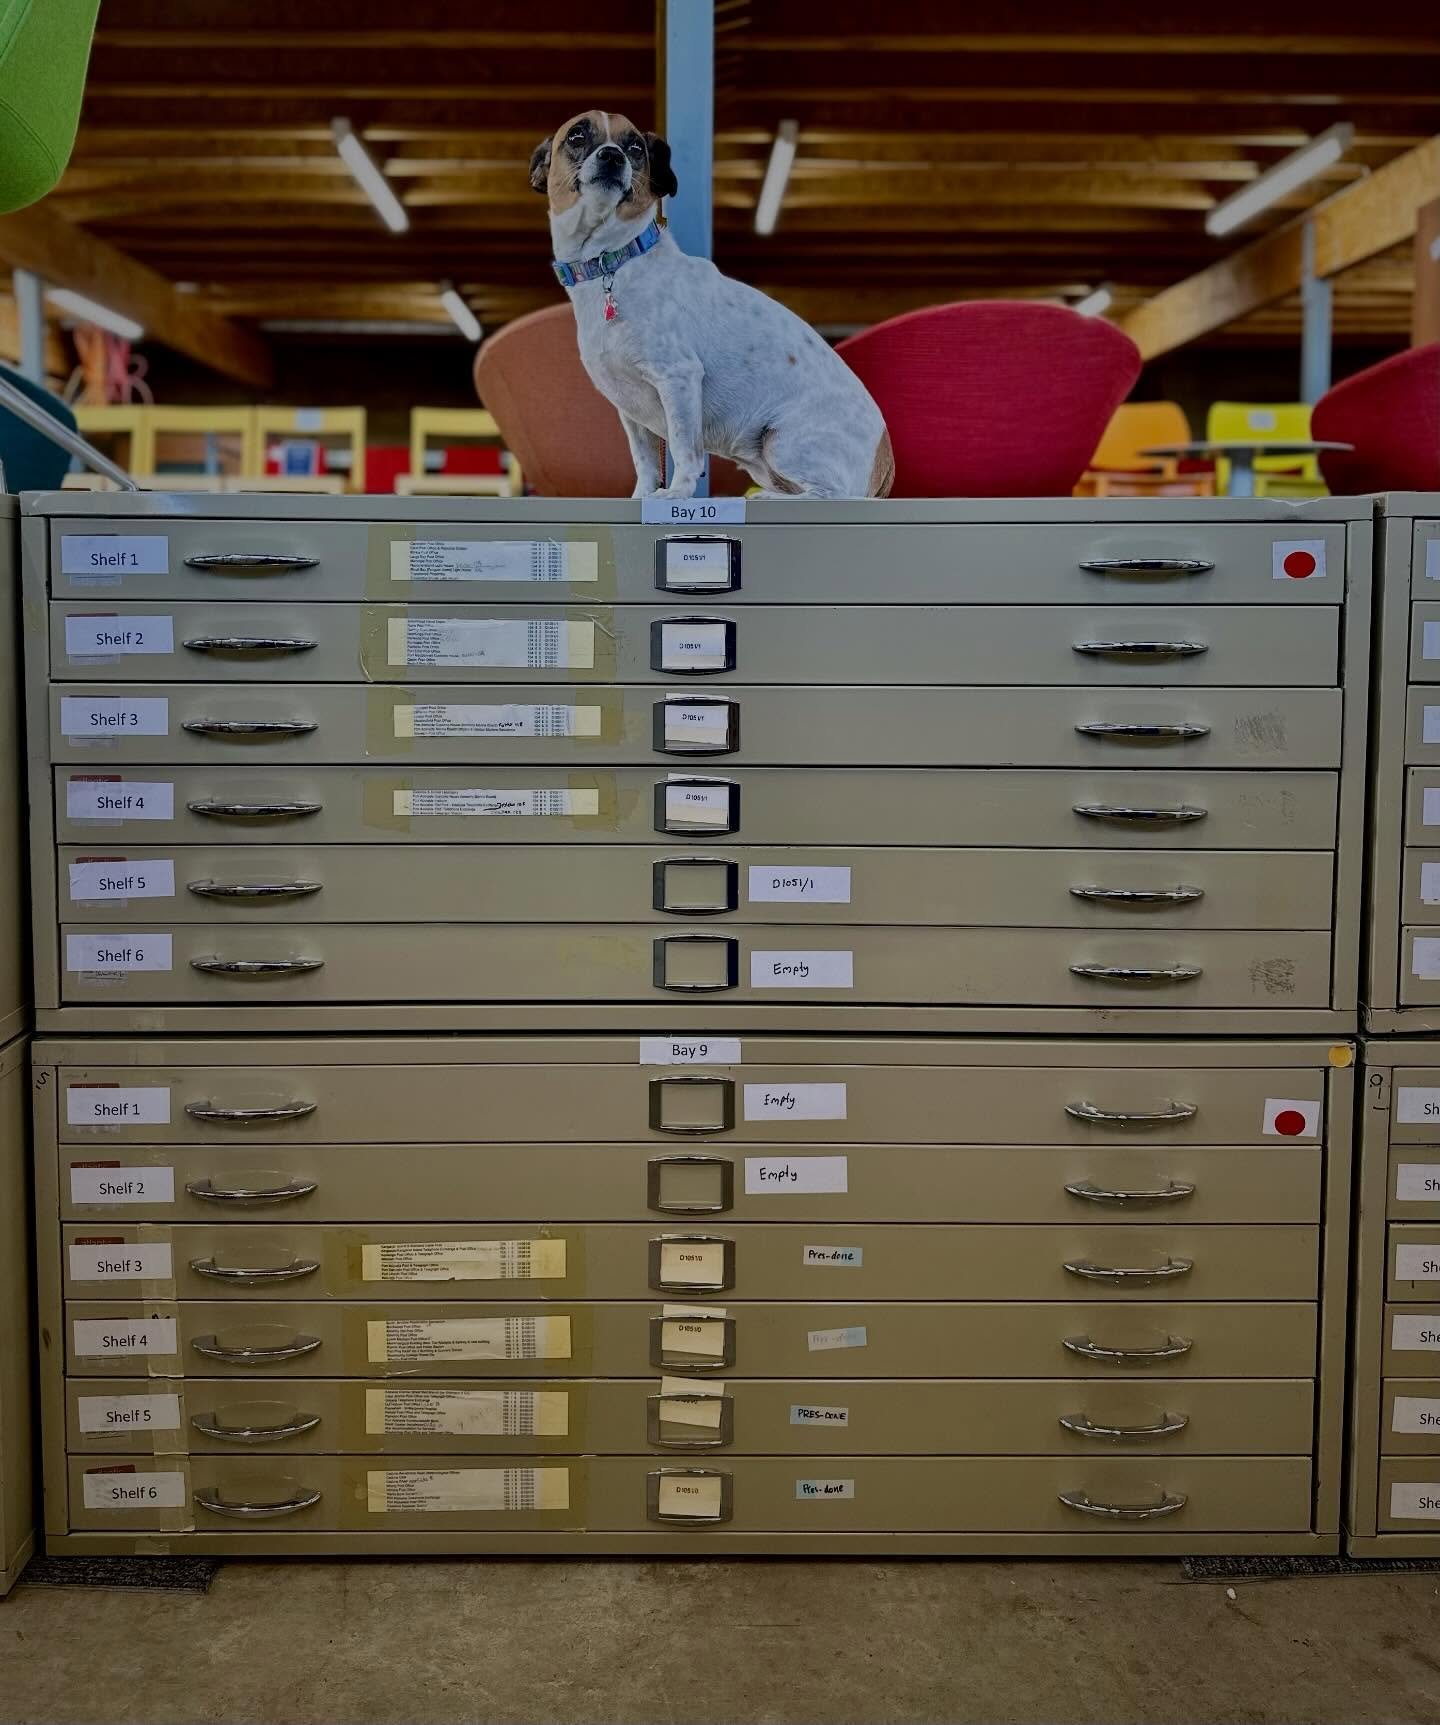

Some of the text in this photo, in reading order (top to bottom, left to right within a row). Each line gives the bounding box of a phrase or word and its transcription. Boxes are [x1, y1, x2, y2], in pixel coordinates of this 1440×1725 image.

[671, 506, 716, 520] Bay 10
[91, 553, 138, 566] Shelf 1
[96, 632, 143, 645] Shelf 2
[91, 713, 137, 725] Shelf 3
[98, 797, 144, 808] Shelf 4
[99, 876, 145, 890] Shelf 5
[773, 878, 814, 893] D1051/1
[97, 949, 143, 961] Shelf 6
[774, 962, 808, 978] Empty
[672, 1045, 707, 1058] Bay 9
[764, 1092, 795, 1110] Empty
[95, 1103, 140, 1115] Shelf 1
[760, 1164, 797, 1183] Empty
[99, 1182, 144, 1194] Shelf 2
[98, 1260, 142, 1273] Shelf 3
[1423, 1261, 1440, 1273] Sh
[102, 1335, 147, 1348] Shelf 4
[107, 1410, 151, 1422] Shelf 5
[112, 1487, 157, 1500] Shelf 6
